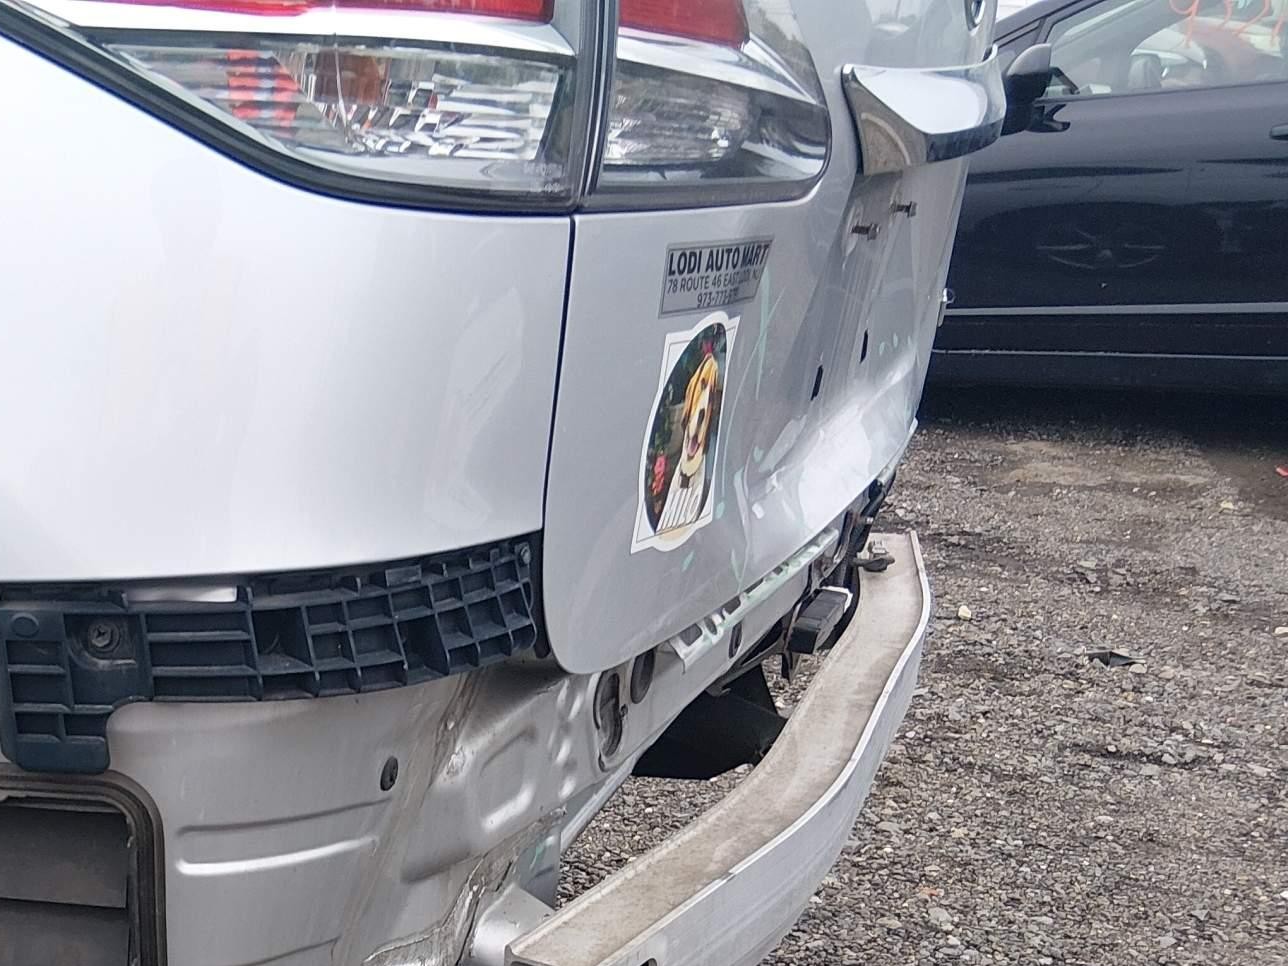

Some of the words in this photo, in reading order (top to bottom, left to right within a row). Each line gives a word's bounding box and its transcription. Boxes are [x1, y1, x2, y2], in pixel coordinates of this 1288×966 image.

[668, 250, 702, 276] LODI
[706, 246, 740, 272] AUTO
[740, 243, 770, 268] MART
[667, 279, 678, 293] 78
[680, 275, 710, 293] ROUTE
[712, 274, 722, 288] 46
